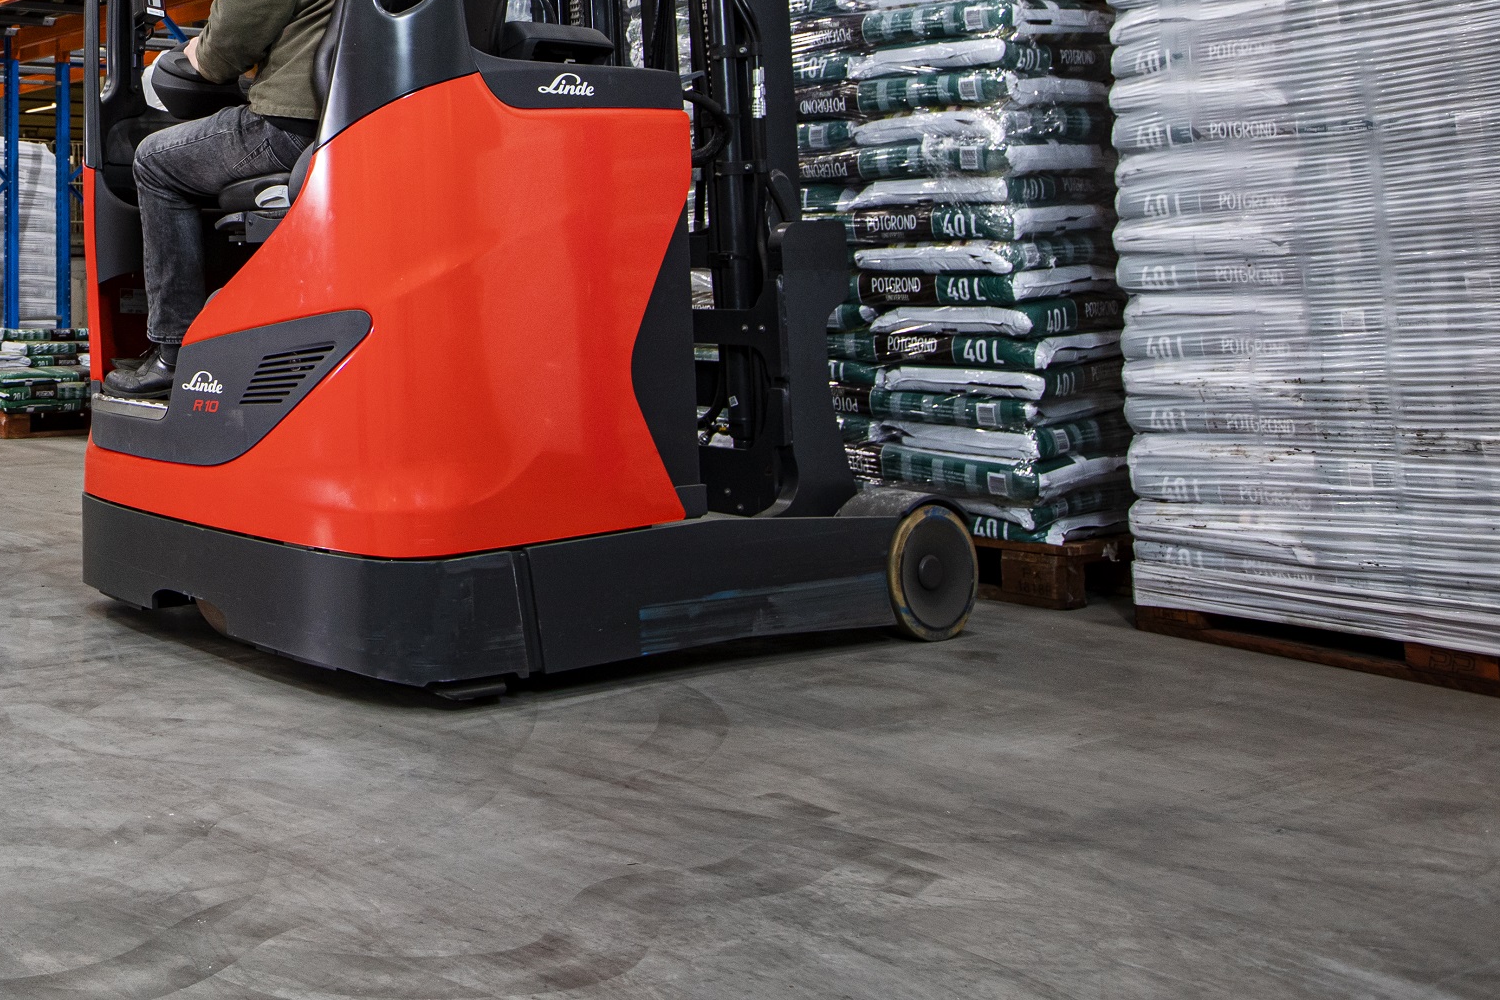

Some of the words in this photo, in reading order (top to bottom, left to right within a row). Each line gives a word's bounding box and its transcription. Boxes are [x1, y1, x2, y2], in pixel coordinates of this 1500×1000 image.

[537, 72, 595, 96] Linde
[800, 97, 846, 114] POTGROND
[1209, 120, 1277, 139] POTGROND
[802, 162, 848, 179] POTGROND
[866, 214, 917, 231] POTGROND
[942, 213, 966, 237] 40
[871, 277, 921, 294] POTGROND
[947, 277, 970, 301] 40
[887, 335, 938, 353] POTGROND
[963, 339, 987, 363] 40
[181, 370, 223, 394] Linde
